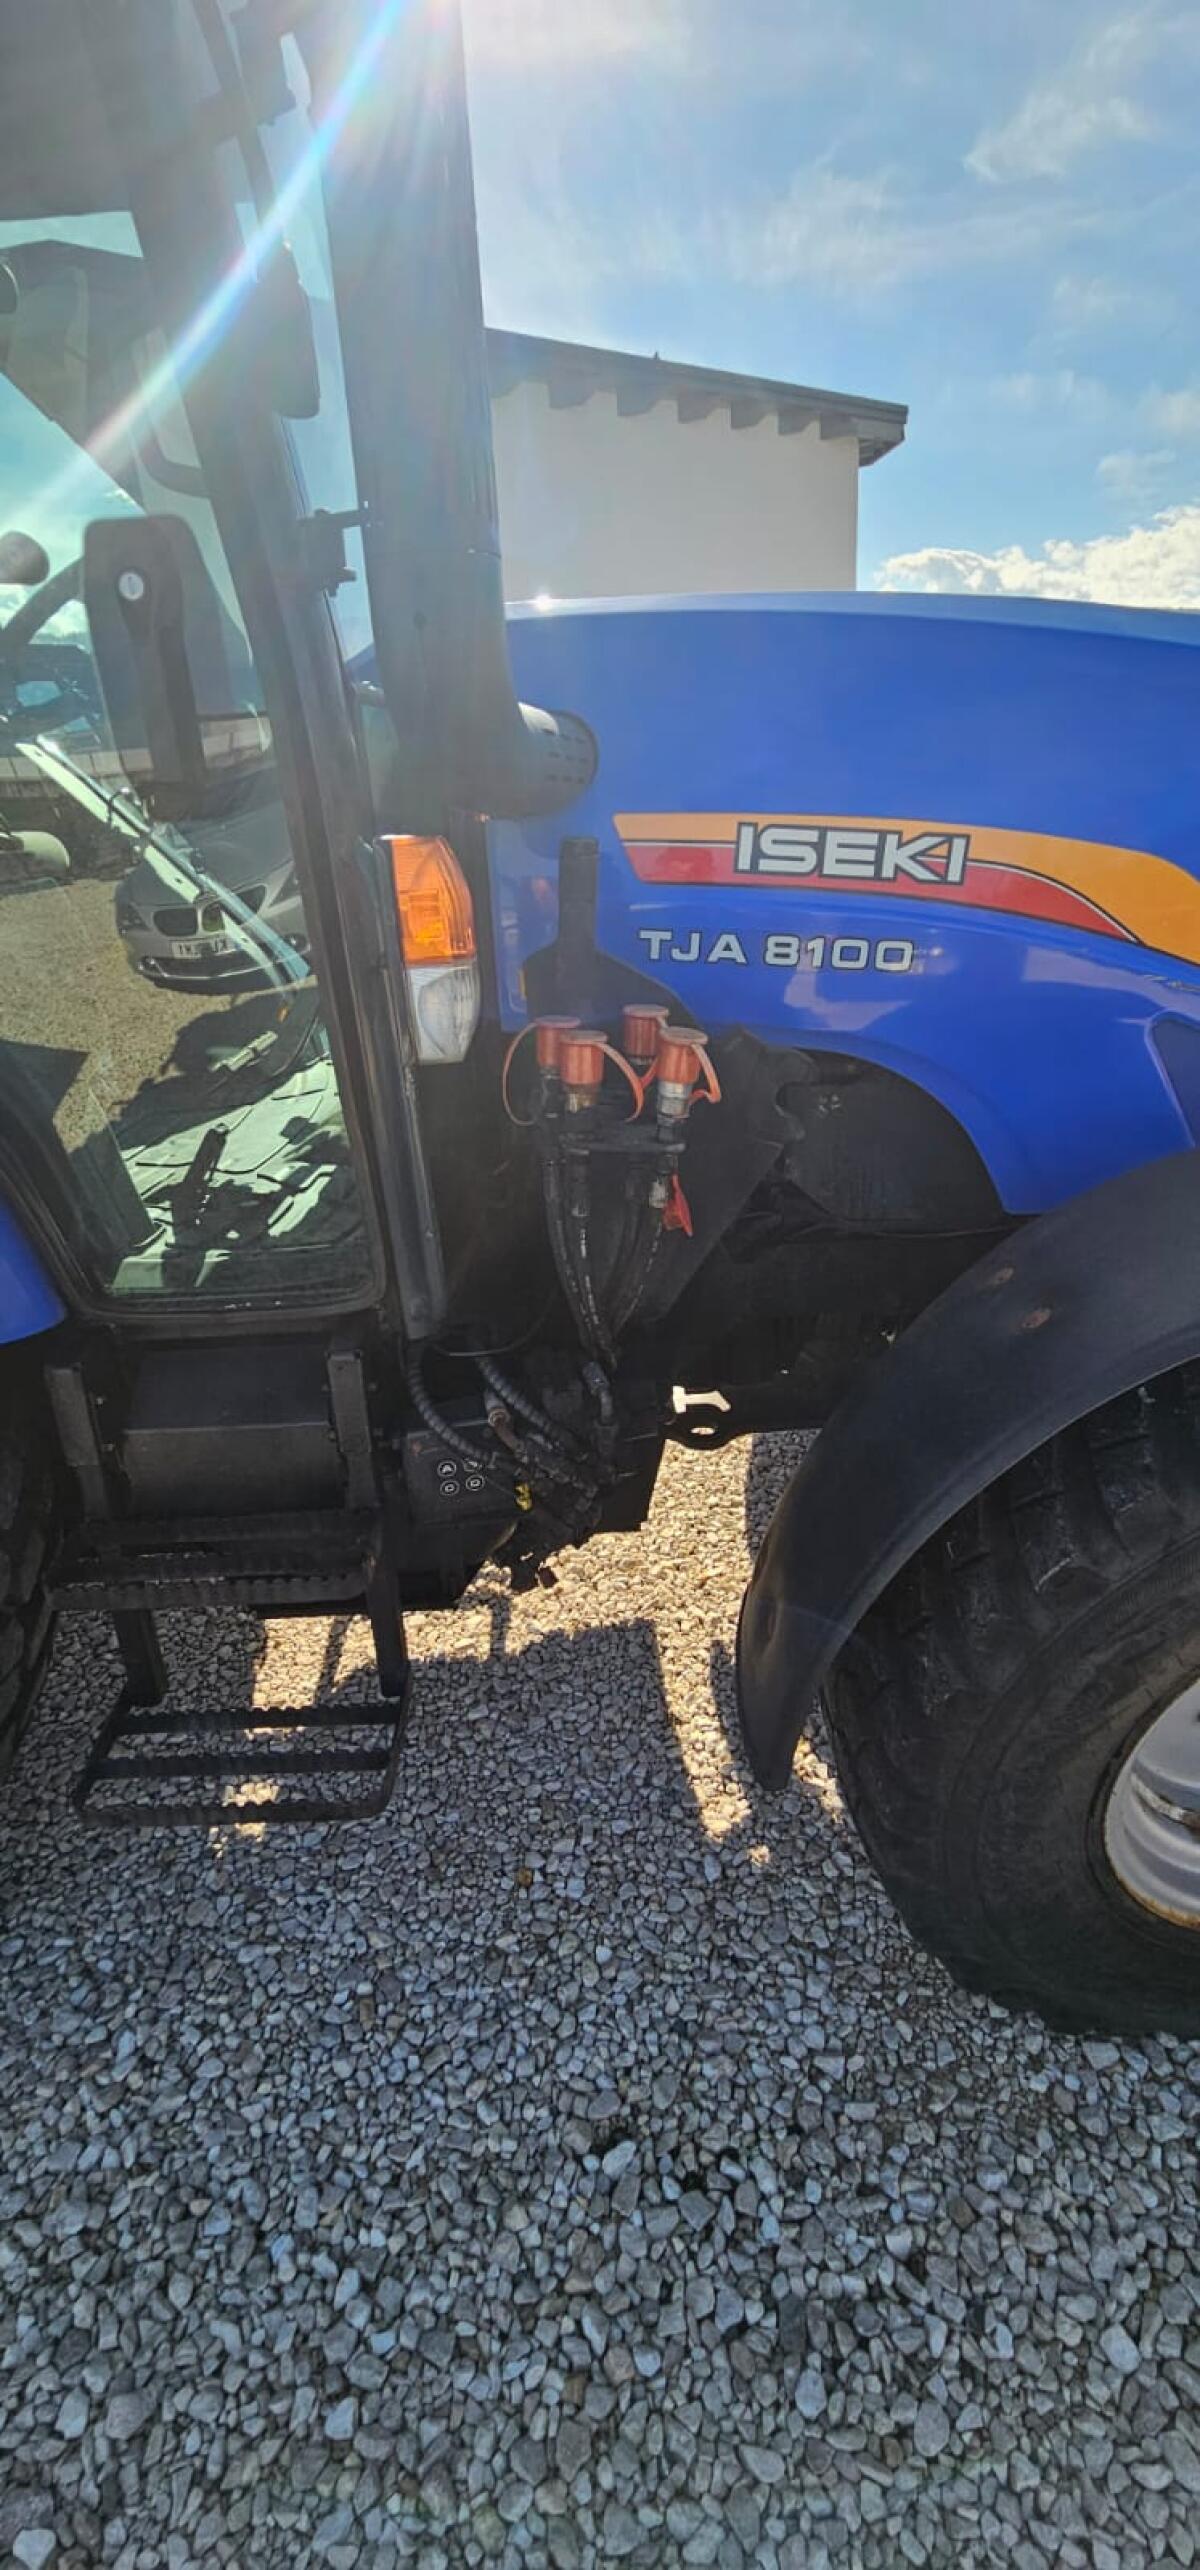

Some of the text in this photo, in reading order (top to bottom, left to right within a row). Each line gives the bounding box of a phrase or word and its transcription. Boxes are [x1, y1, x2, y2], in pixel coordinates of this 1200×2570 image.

[735, 822, 969, 884] ISEKI
[639, 930, 914, 971] TJA 8100
